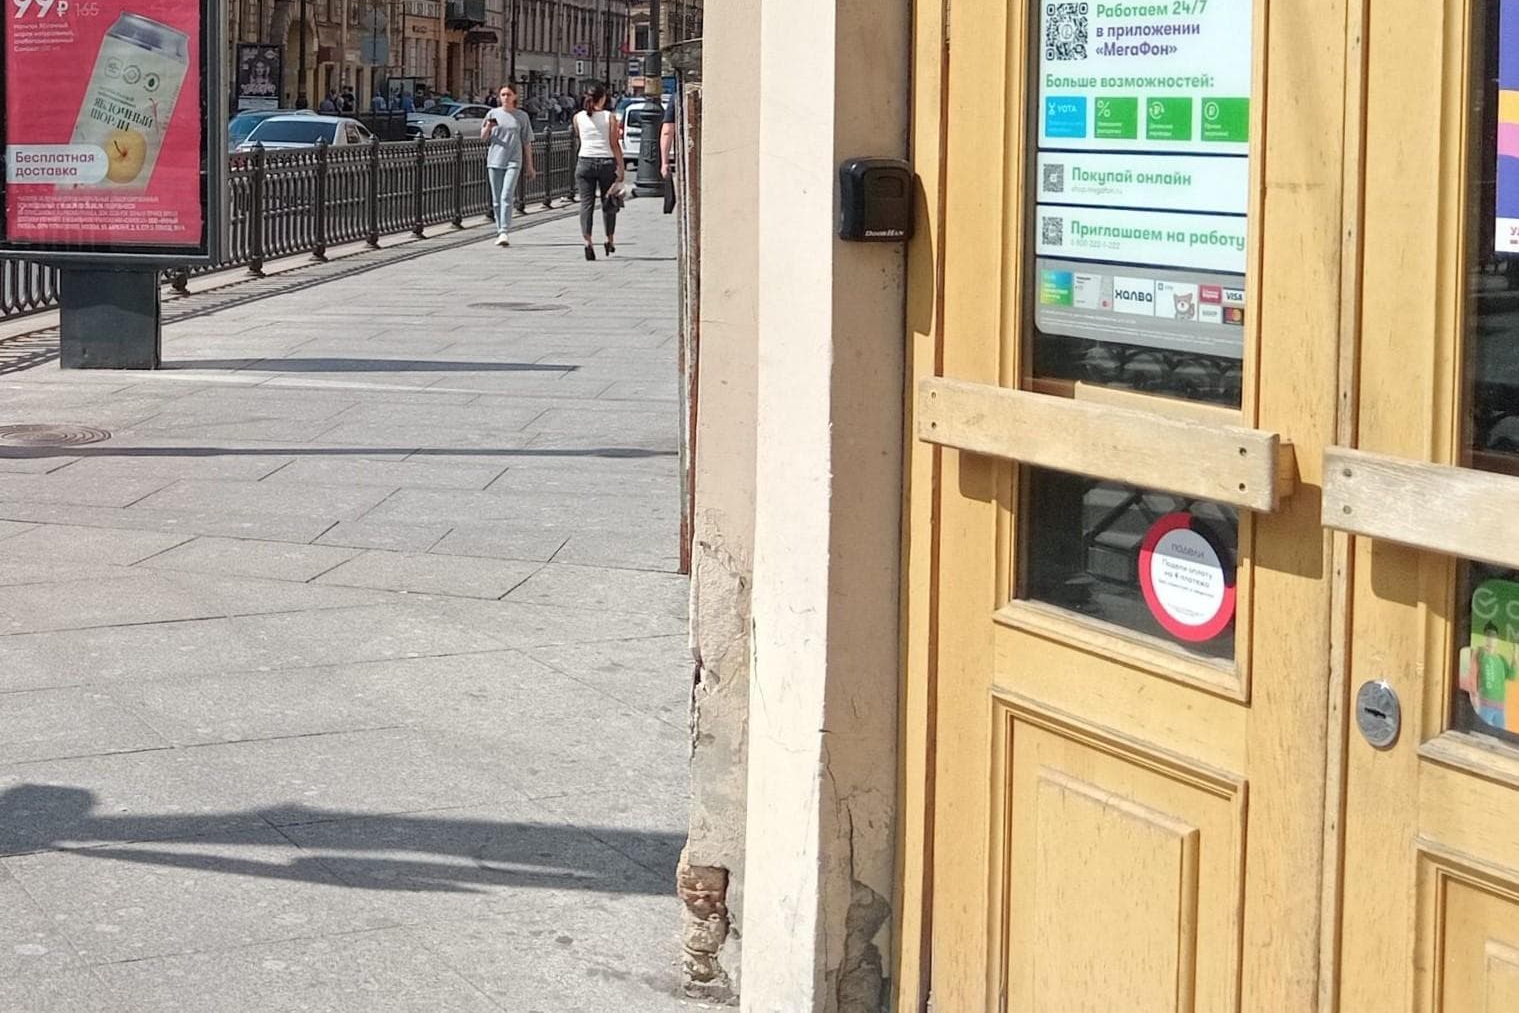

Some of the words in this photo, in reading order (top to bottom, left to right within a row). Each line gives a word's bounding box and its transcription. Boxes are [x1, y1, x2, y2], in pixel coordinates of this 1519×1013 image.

[1096, 3, 1168, 18] Работаем
[1172, 0, 1208, 16] 24/7
[1096, 26, 1104, 37] в
[1107, 23, 1201, 40] приложении
[1095, 41, 1178, 57] «МегаФон»
[1046, 73, 1097, 88] Больше
[1101, 73, 1215, 88] возможностей:
[15, 151, 94, 163] Бесплатная
[15, 166, 77, 178] доставка
[1072, 166, 1133, 186] Покупай
[1137, 169, 1191, 186] онлайн
[1071, 220, 1162, 241] Приглашаем
[1167, 230, 1185, 243] на
[1189, 230, 1245, 251] работу
